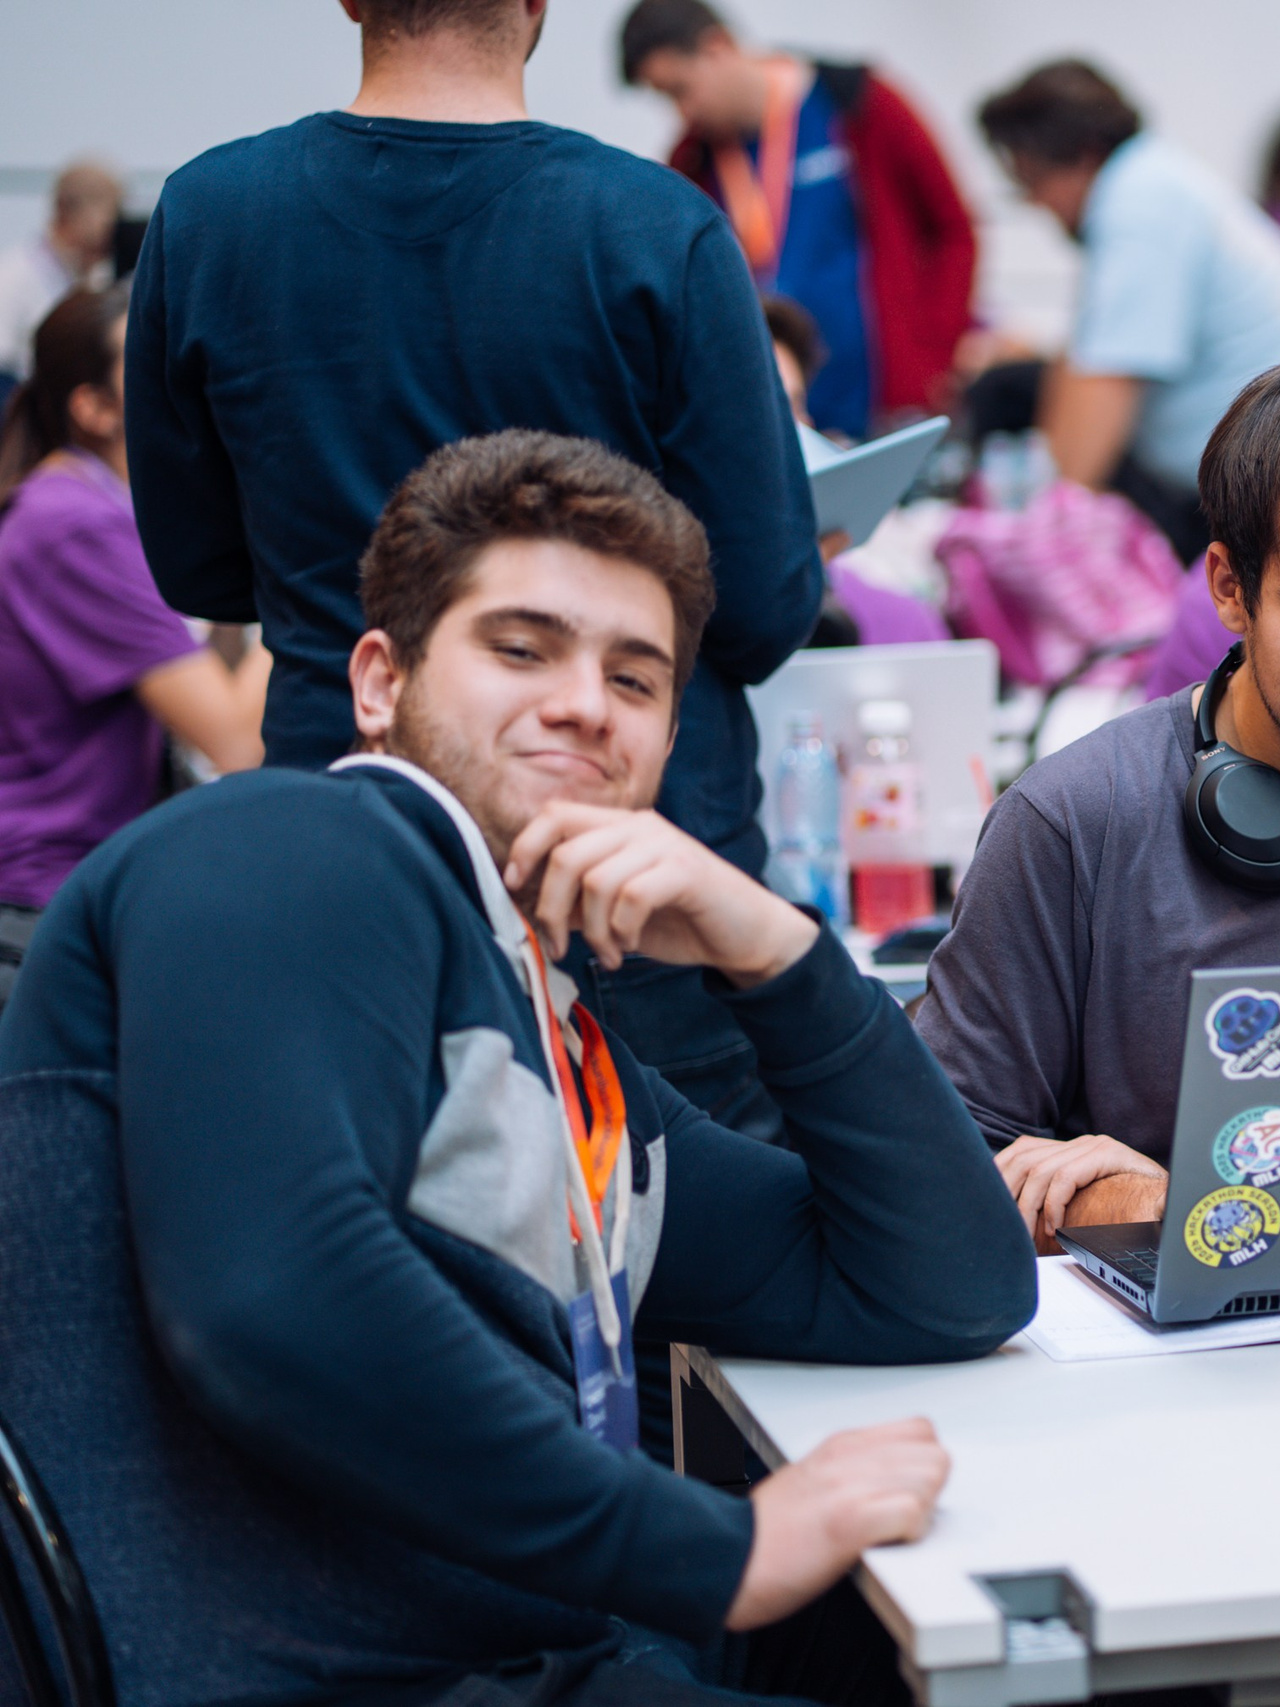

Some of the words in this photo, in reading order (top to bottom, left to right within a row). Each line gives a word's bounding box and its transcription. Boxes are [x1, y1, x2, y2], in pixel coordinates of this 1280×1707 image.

[1201, 747, 1226, 761] SONY
[1188, 1188, 1245, 1237] HACKATHON
[1249, 1190, 1278, 1224] SEASON
[1229, 1238, 1268, 1266] MLH
